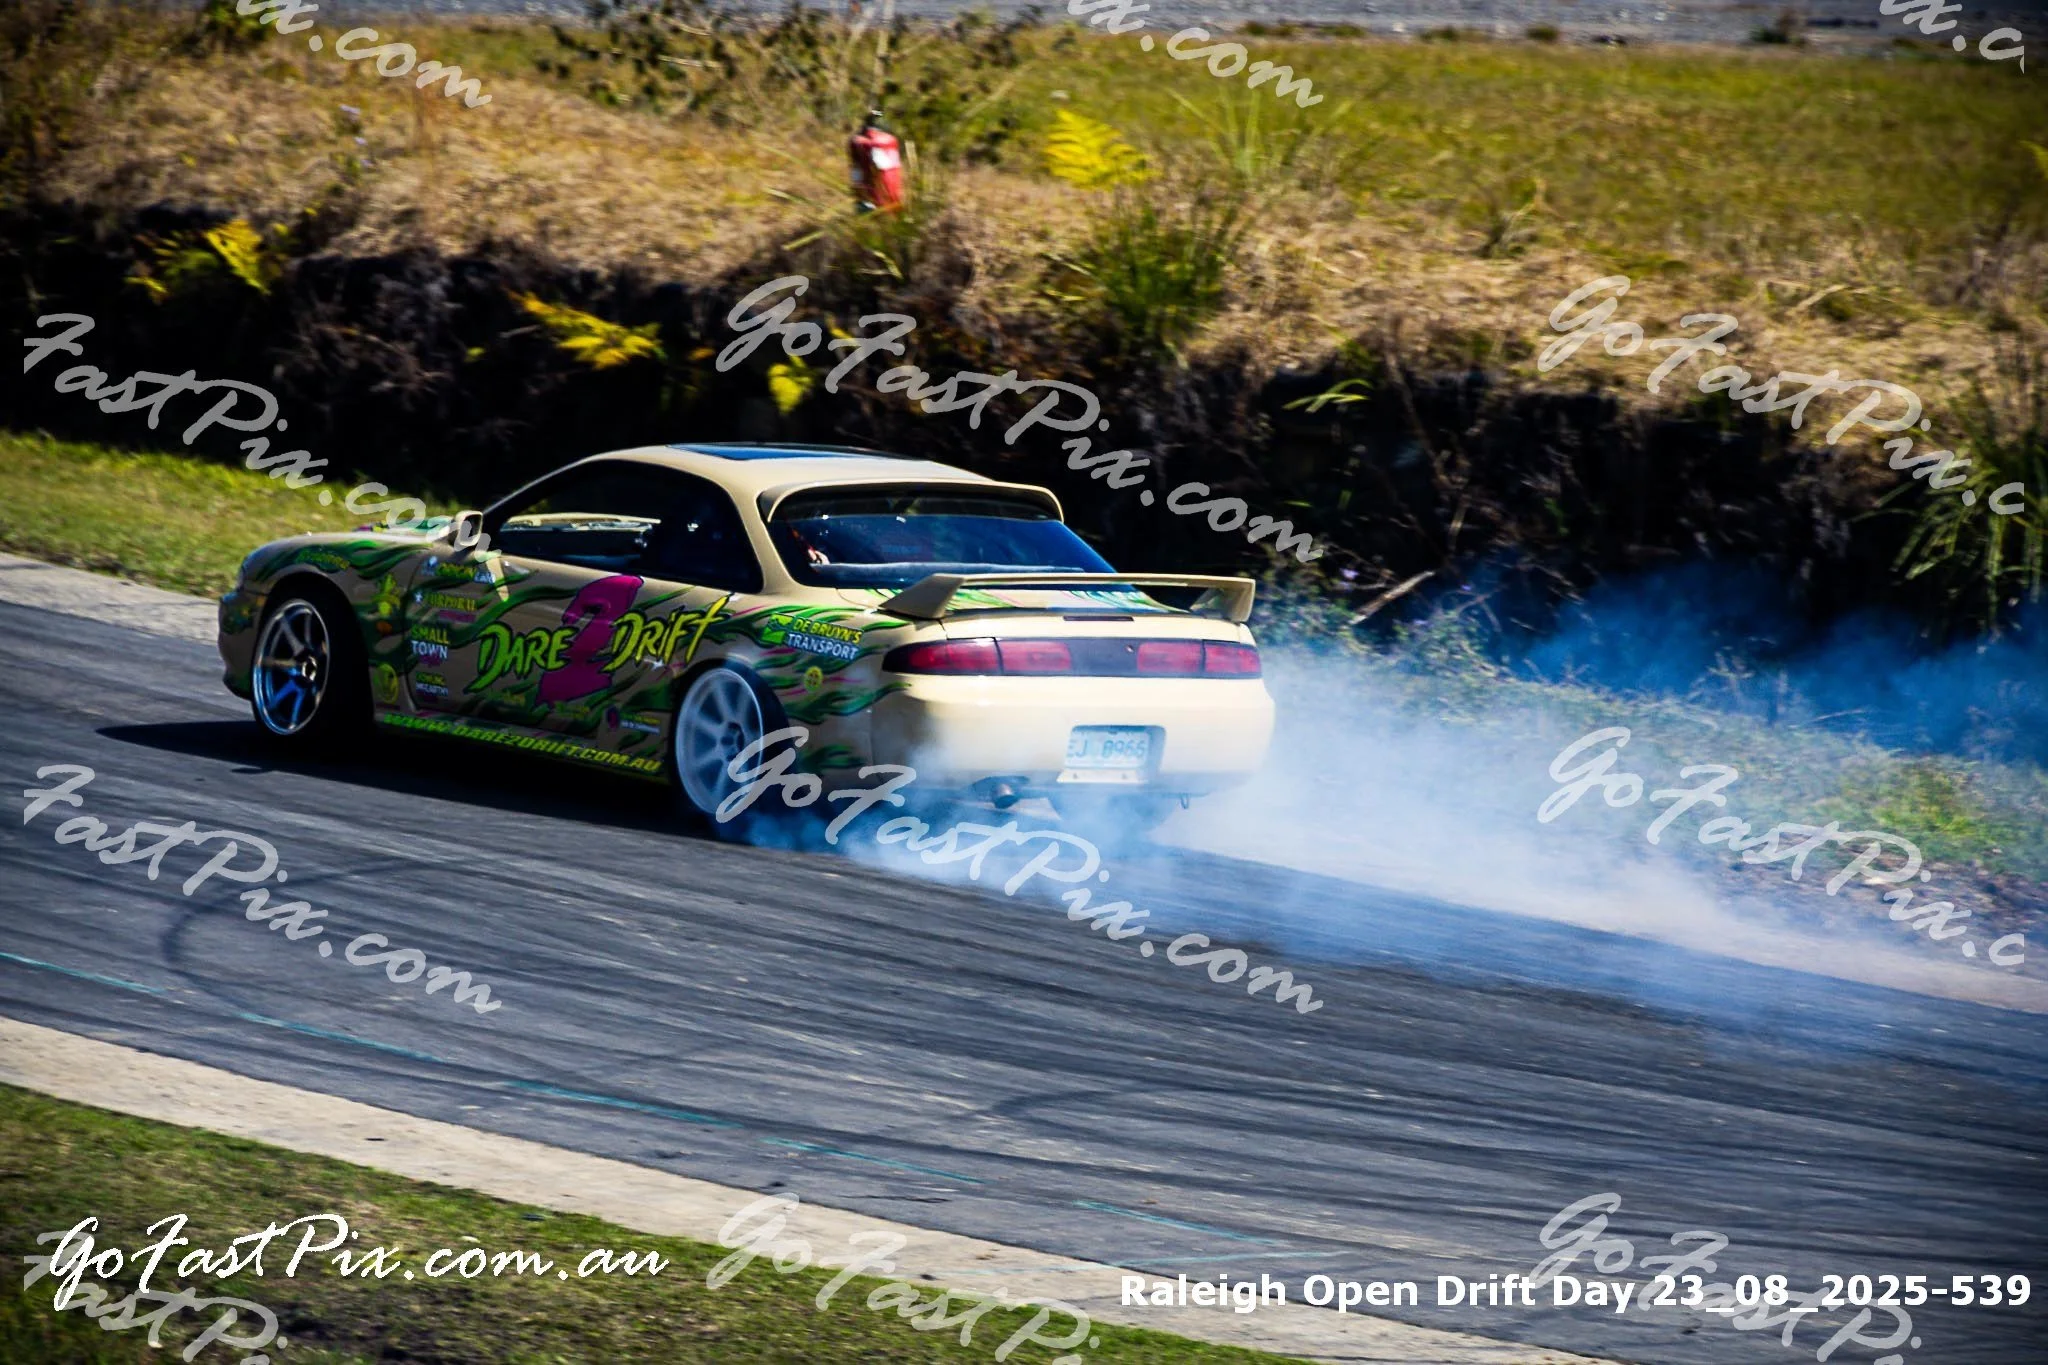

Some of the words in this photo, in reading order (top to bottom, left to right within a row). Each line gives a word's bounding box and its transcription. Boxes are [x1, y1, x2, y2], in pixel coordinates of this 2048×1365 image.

[411, 623, 449, 644] SMALL
[793, 618, 811, 632] DE
[411, 639, 448, 659] TOWN
[537, 573, 645, 707] 2
[787, 632, 859, 660] TRANSPORT
